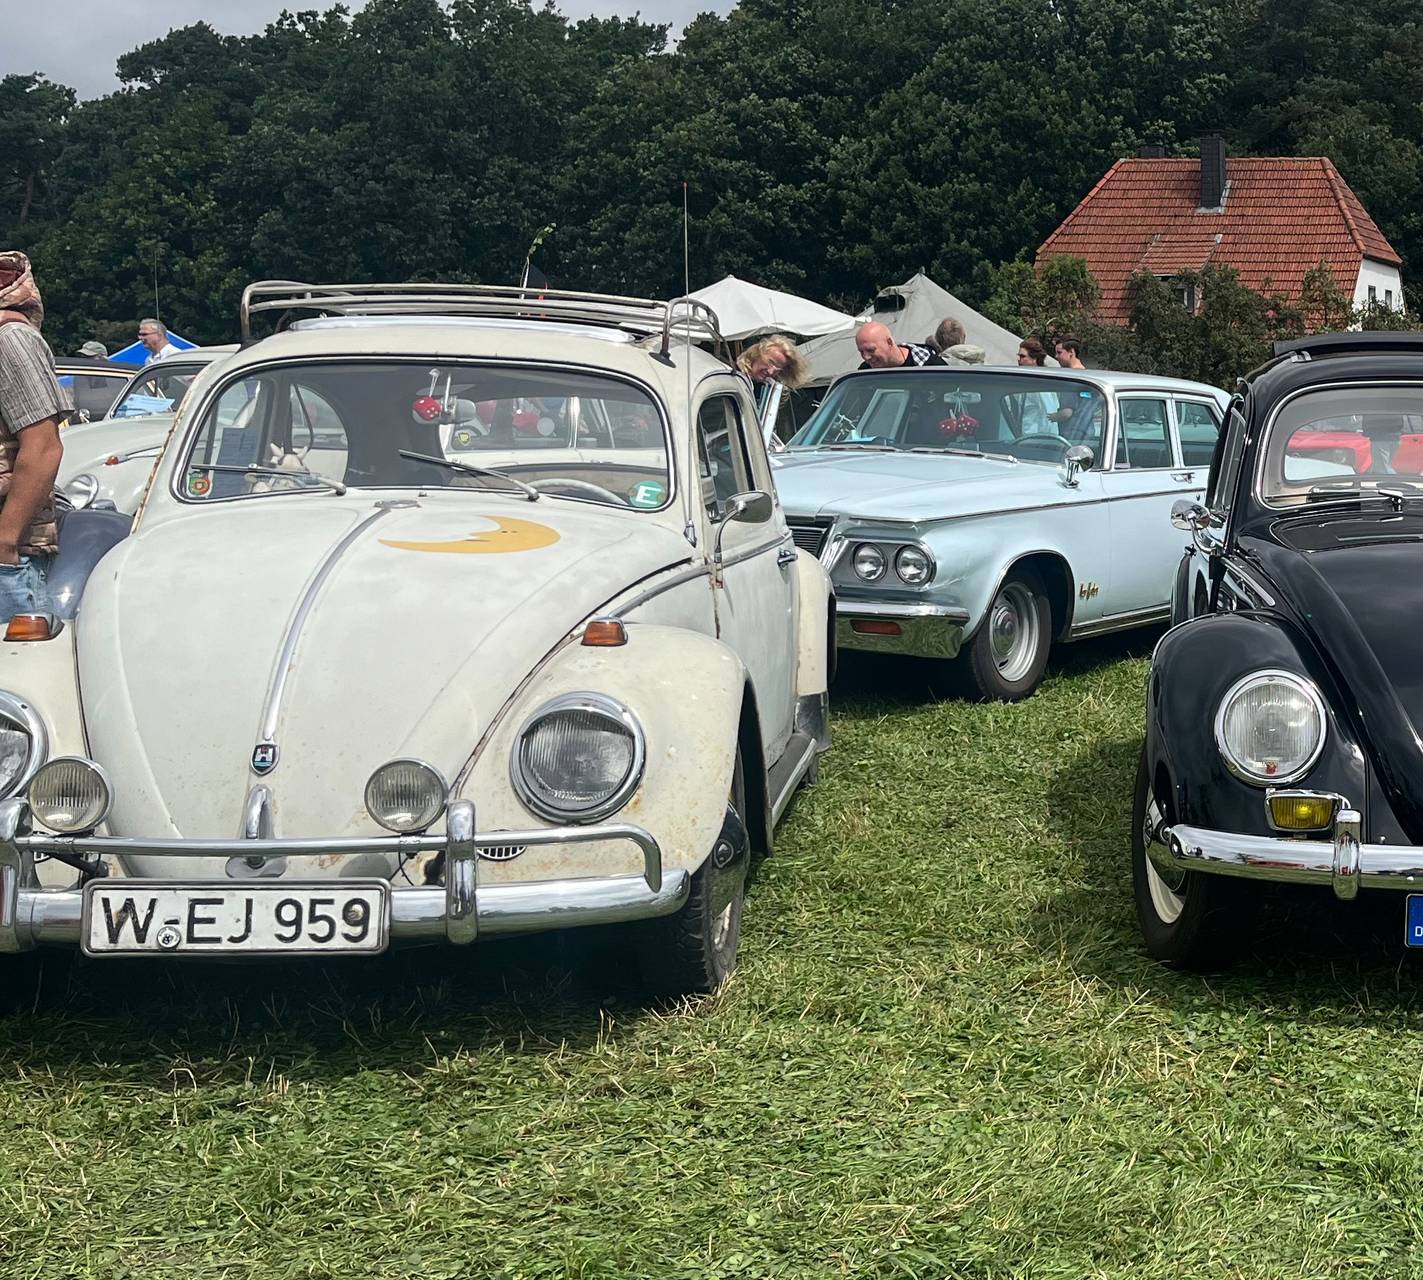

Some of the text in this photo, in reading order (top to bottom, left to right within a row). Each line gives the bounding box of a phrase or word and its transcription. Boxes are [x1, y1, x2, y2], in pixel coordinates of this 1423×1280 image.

[635, 485, 662, 505] E
[274, 897, 371, 944] 959
[1414, 926, 1423, 937] D
